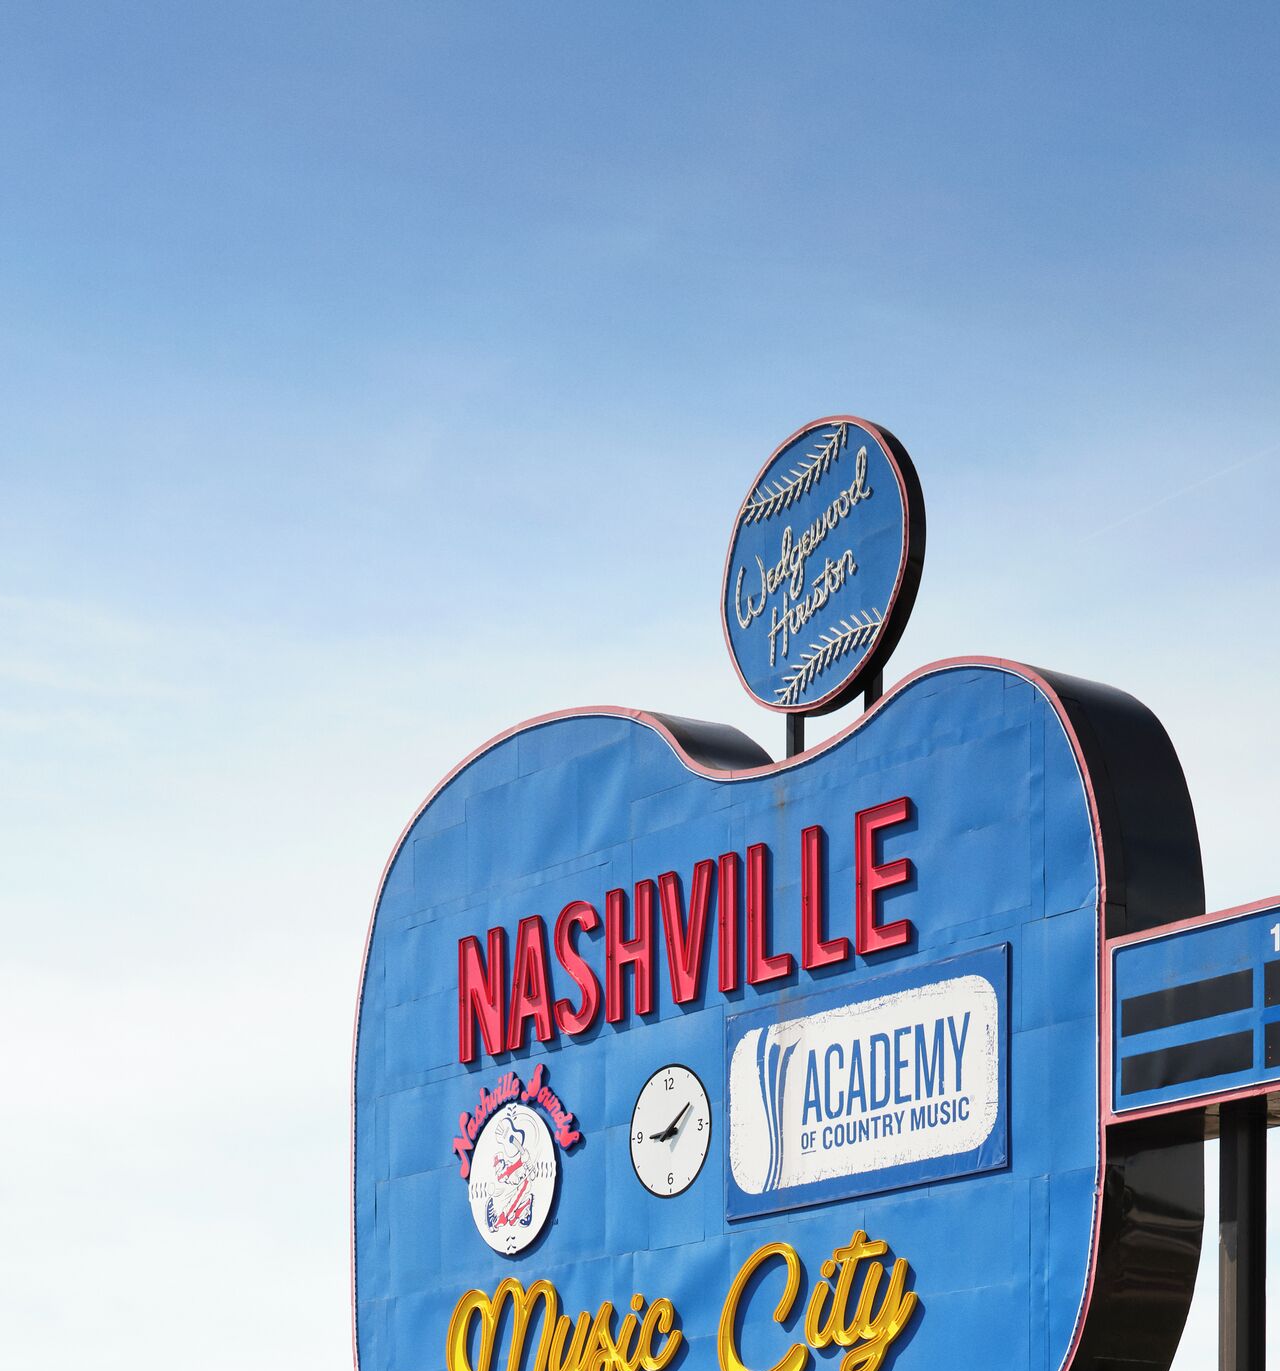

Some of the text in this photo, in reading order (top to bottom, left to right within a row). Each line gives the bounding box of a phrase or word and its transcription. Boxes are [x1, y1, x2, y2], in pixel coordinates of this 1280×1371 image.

[735, 446, 872, 629] Wedgewood
[768, 550, 856, 667] Houston
[457, 796, 912, 1065] NASHVILLE
[1270, 923, 1280, 952] 1
[664, 1077, 675, 1091] 12
[802, 1011, 971, 1126] ACADEMY
[453, 1063, 580, 1179] Nashville Sounds
[636, 1131, 644, 1144] 9
[697, 1118, 704, 1132] 3
[801, 1096, 970, 1150] OF COUNTRY MUSIC
[667, 1172, 674, 1185] 6
